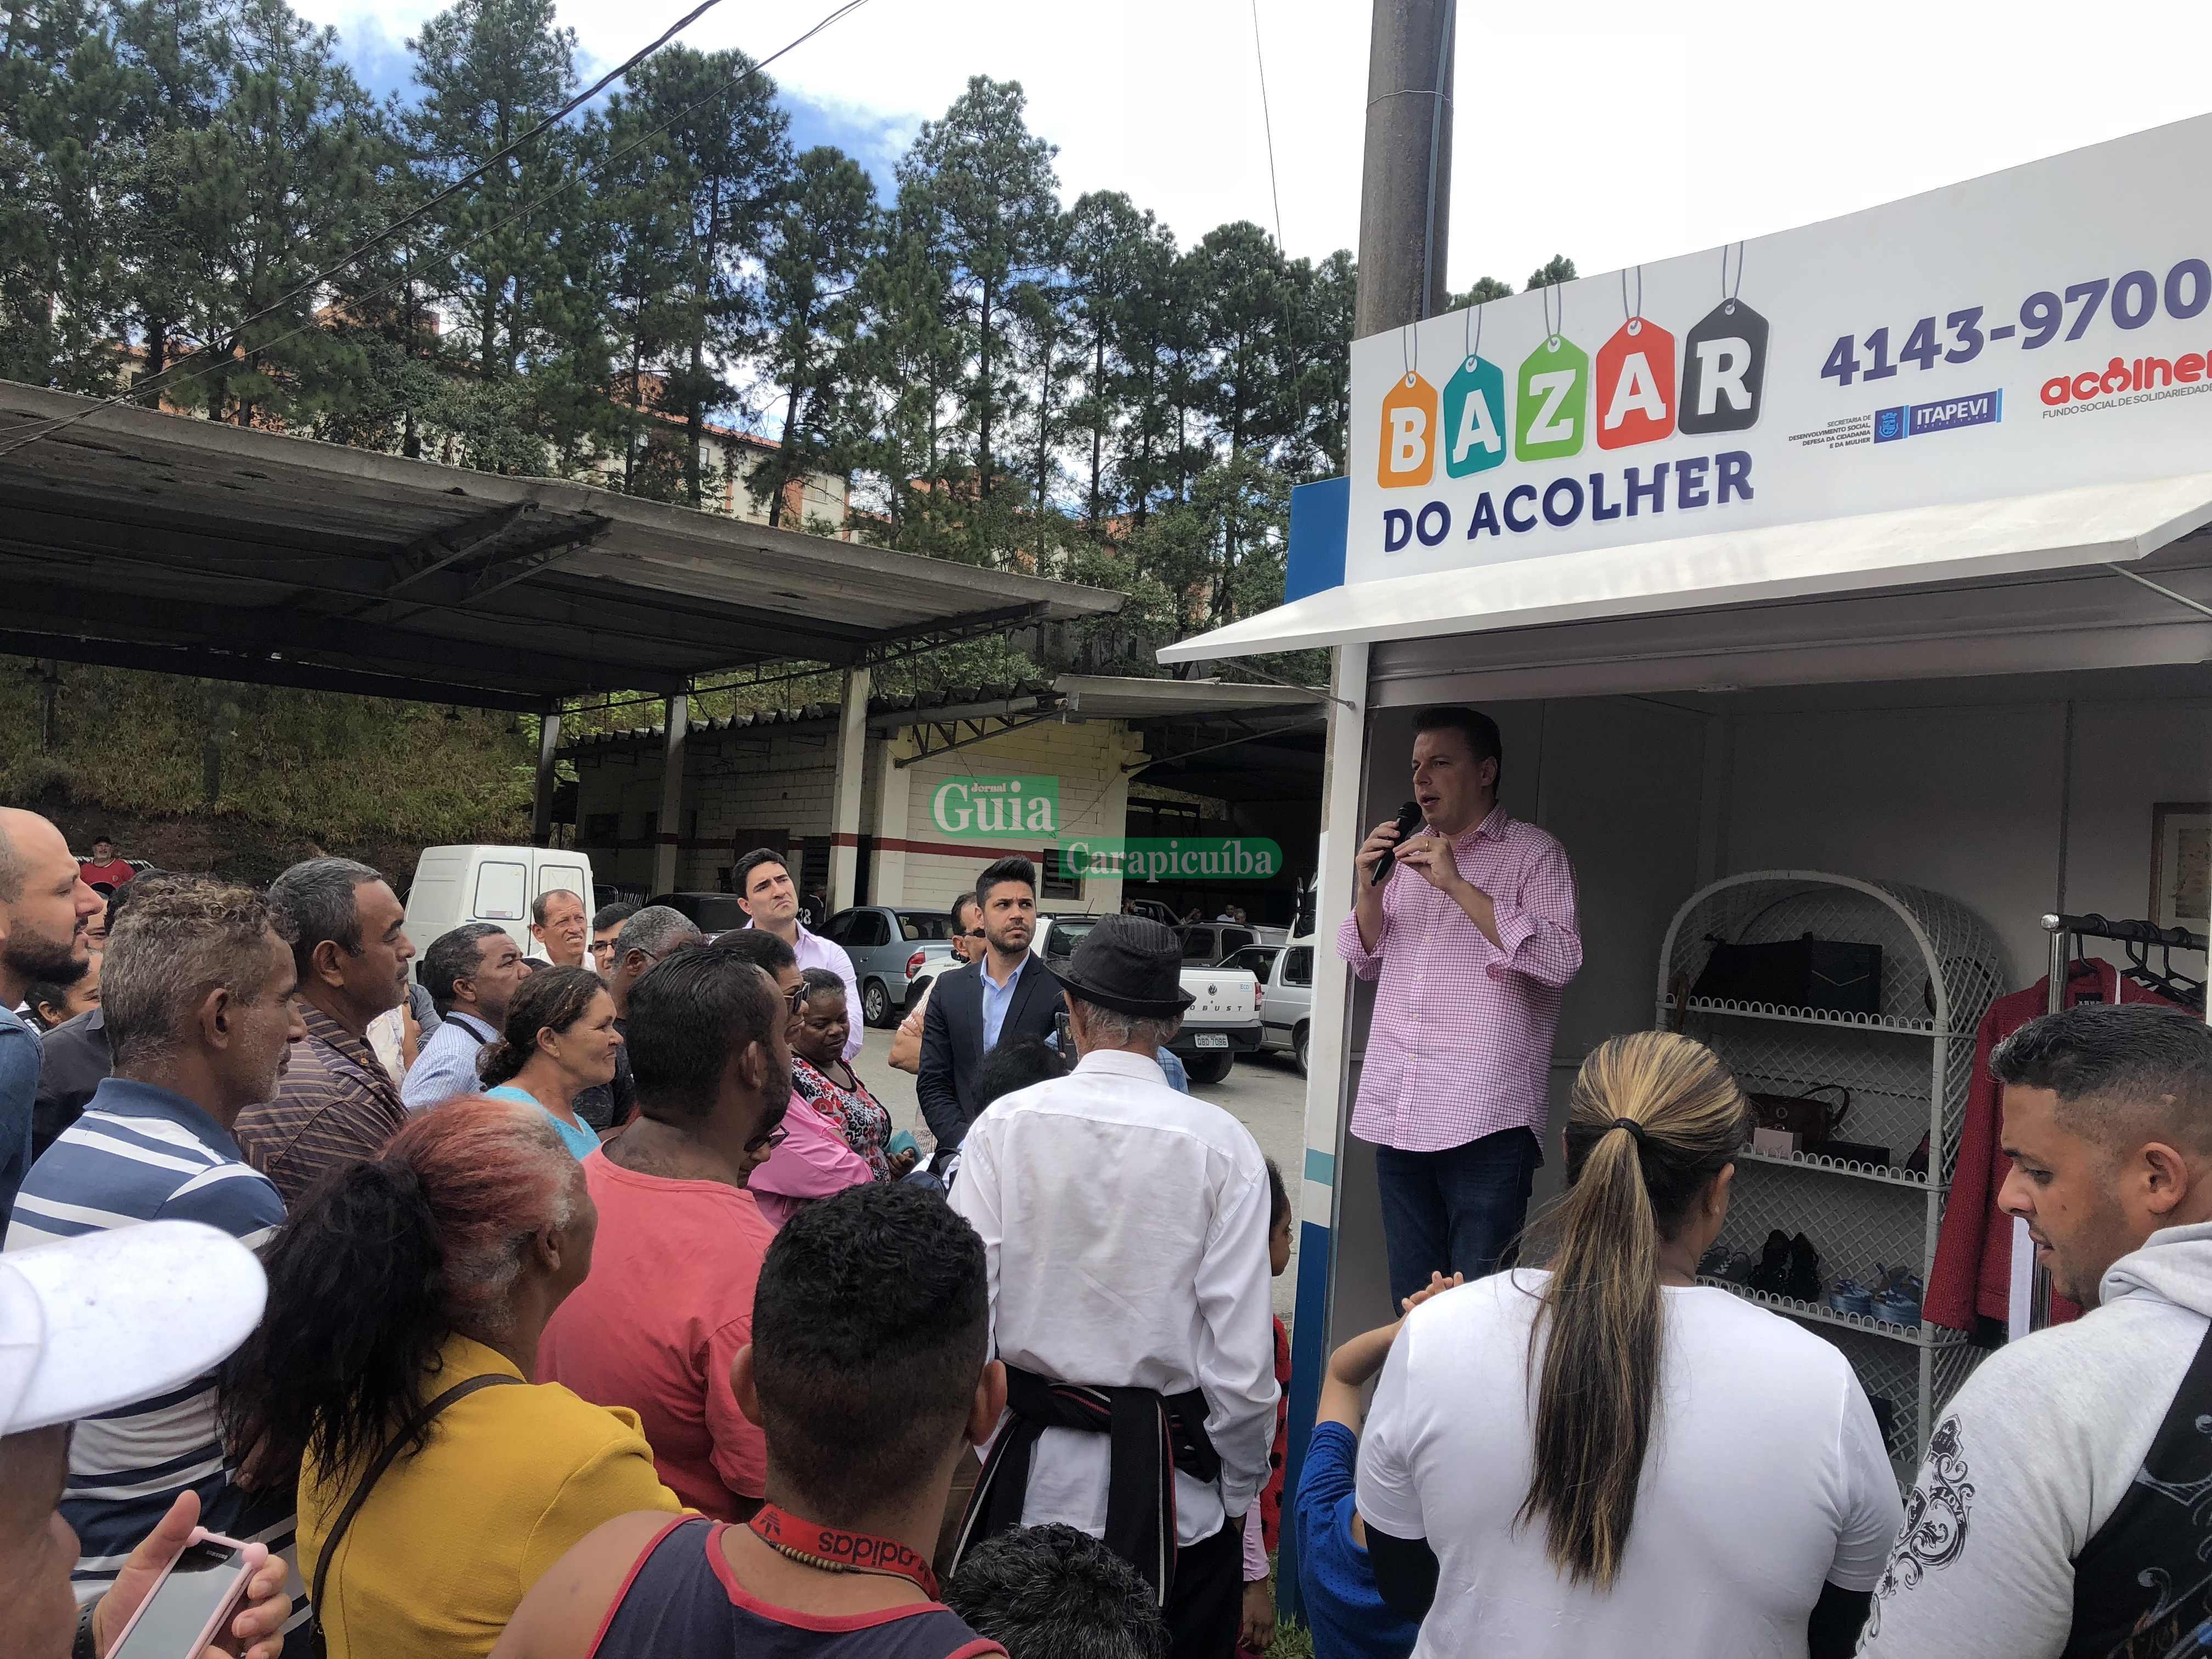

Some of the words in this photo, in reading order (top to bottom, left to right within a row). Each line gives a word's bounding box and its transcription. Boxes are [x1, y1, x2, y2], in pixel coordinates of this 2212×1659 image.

[1820, 258, 2212, 386] 4143-9700
[1390, 336, 1753, 473] BAZAR
[1917, 398, 1988, 425] ITAPEVI
[2042, 406, 2079, 419] FUNDO
[2080, 399, 2118, 413] SOCIAL
[2118, 396, 2132, 407] DE
[1788, 426, 1846, 441] DESENVOLVIMENTO
[1847, 422, 1871, 432] SOCIAL,
[1827, 416, 1861, 427] SECRETARIA
[1916, 415, 1987, 430] PREFEITURA
[1802, 437, 1825, 446] DEFESA
[1836, 430, 1871, 440] CIDADANIA
[1845, 437, 1871, 446] MULHER
[1383, 500, 1452, 553] DO
[1466, 450, 1754, 541] ACOLHER
[1939, 1488, 1965, 1524] LOVE
